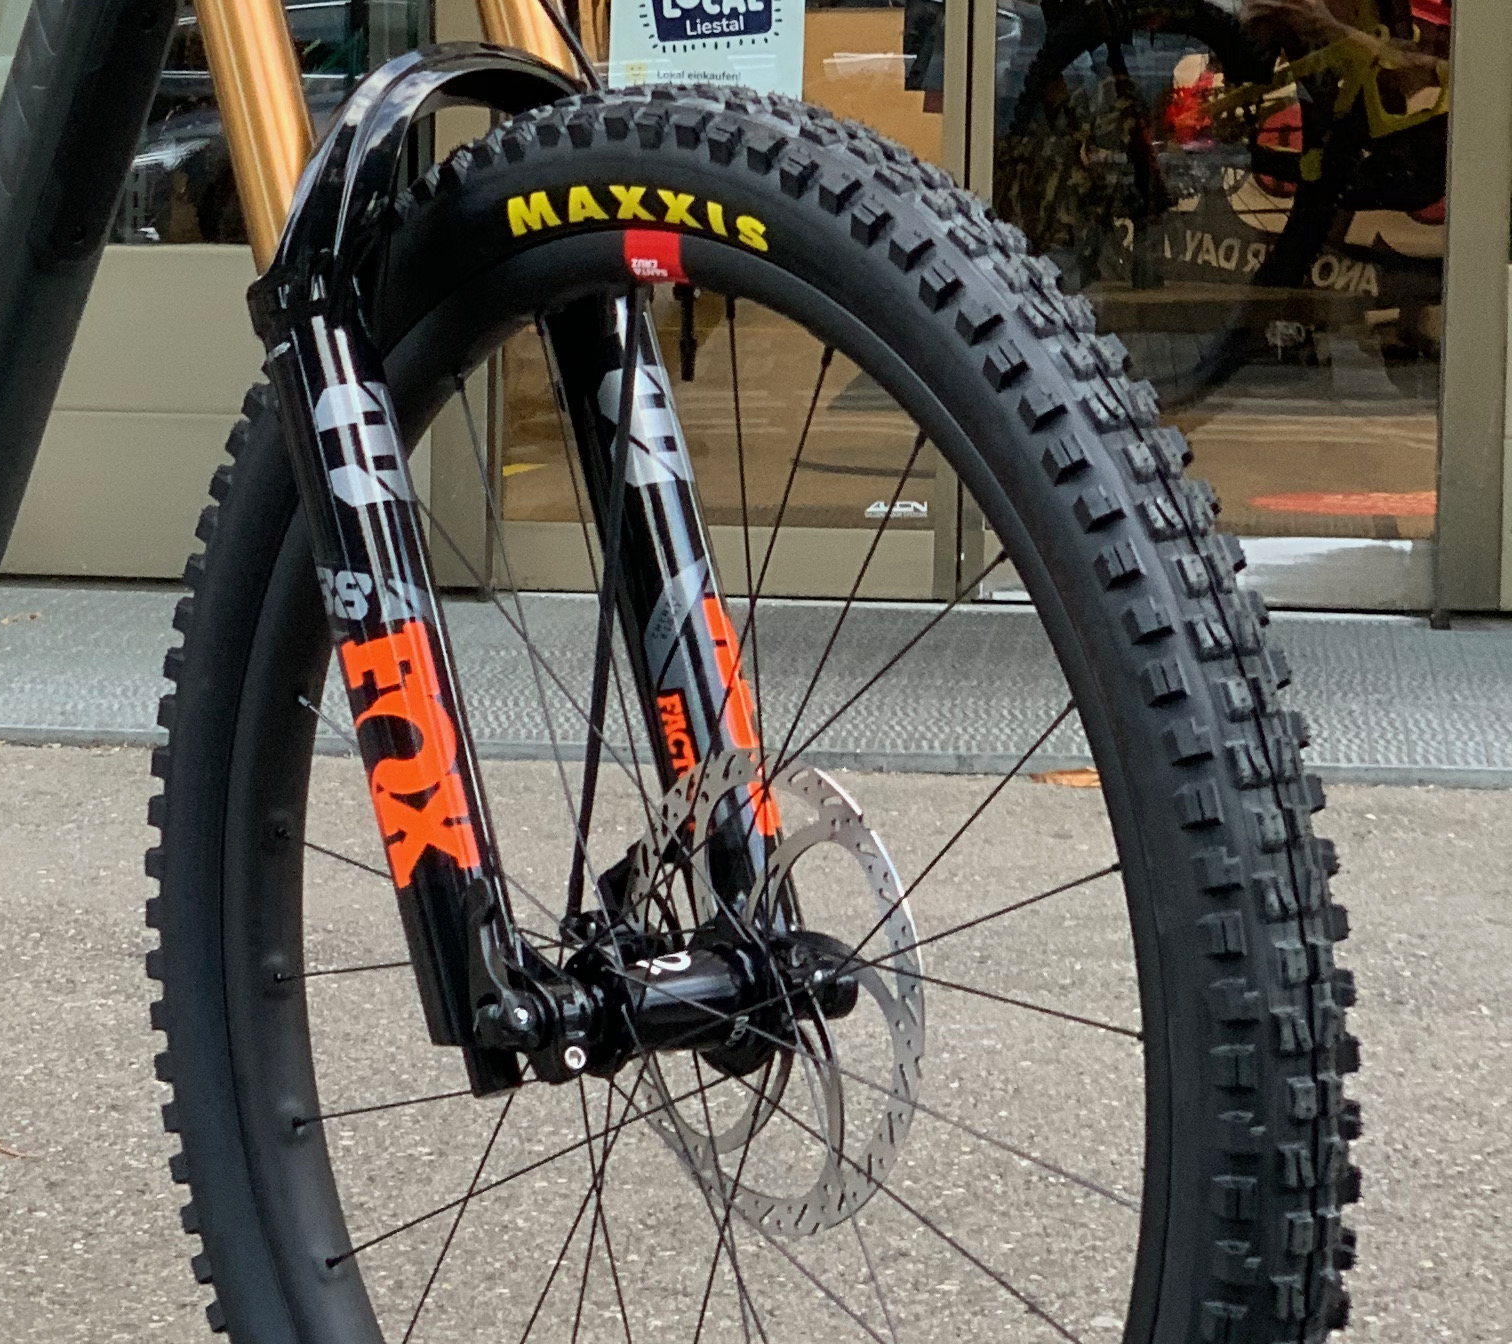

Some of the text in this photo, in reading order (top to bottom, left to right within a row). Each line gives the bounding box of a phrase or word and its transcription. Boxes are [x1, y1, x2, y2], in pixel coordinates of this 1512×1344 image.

[685, 15, 746, 36] Liestal
[656, 69, 742, 81] Lokal einkaufen!
[507, 184, 770, 252] MAXXIS
[340, 620, 482, 890] FOX
